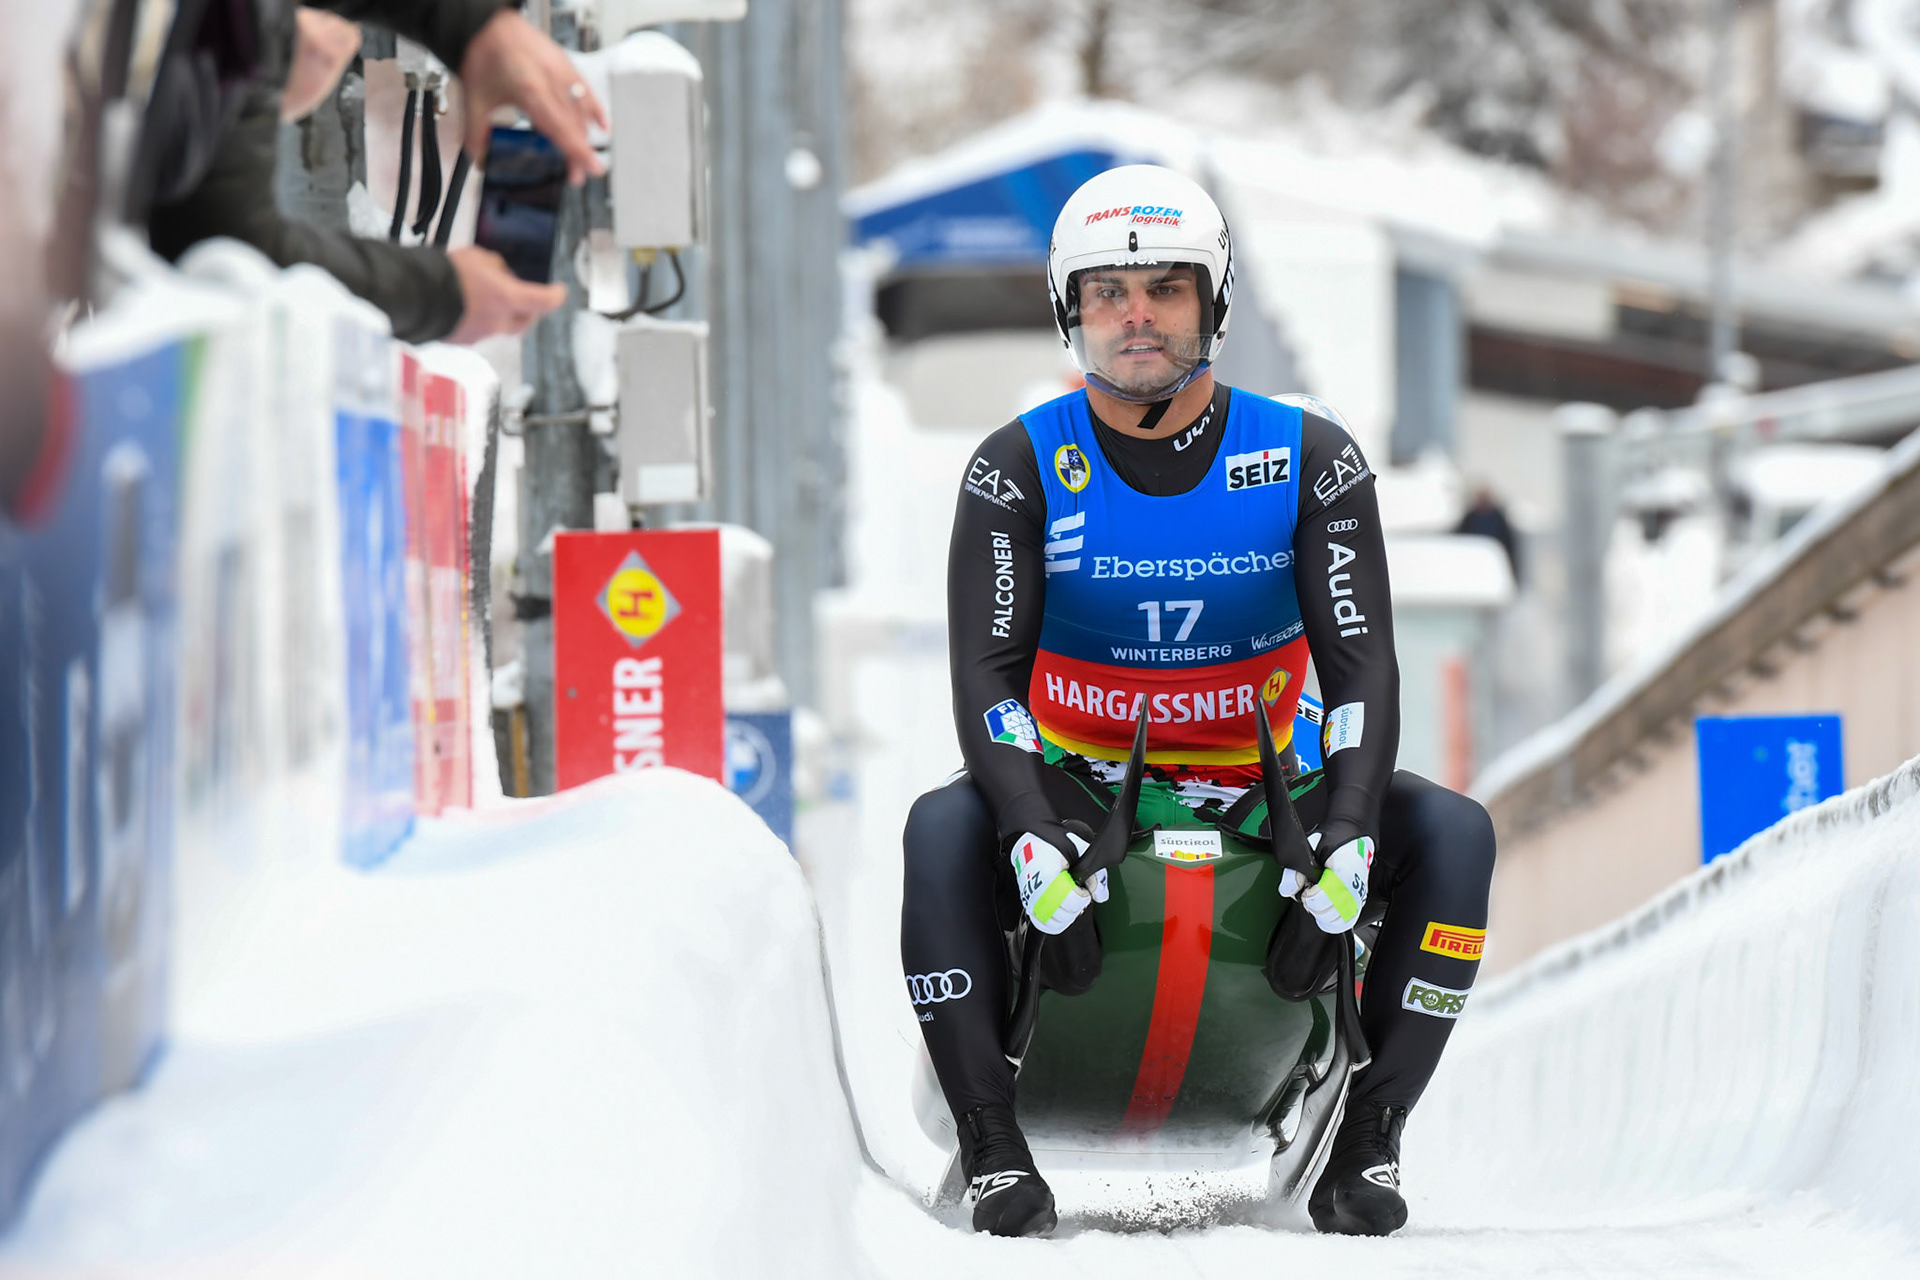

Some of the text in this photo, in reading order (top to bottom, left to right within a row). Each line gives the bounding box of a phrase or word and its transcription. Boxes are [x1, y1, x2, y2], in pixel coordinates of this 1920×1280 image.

[1131, 213, 1180, 227] logistik
[990, 531, 1015, 638] FALCONERI
[1327, 542, 1369, 638] Audi
[1137, 599, 1205, 643] 17
[1110, 644, 1233, 662] WINTERBERG
[1045, 672, 1255, 724] HARGASSNER
[917, 1011, 936, 1023] udi
[1406, 984, 1470, 1014] FORS
